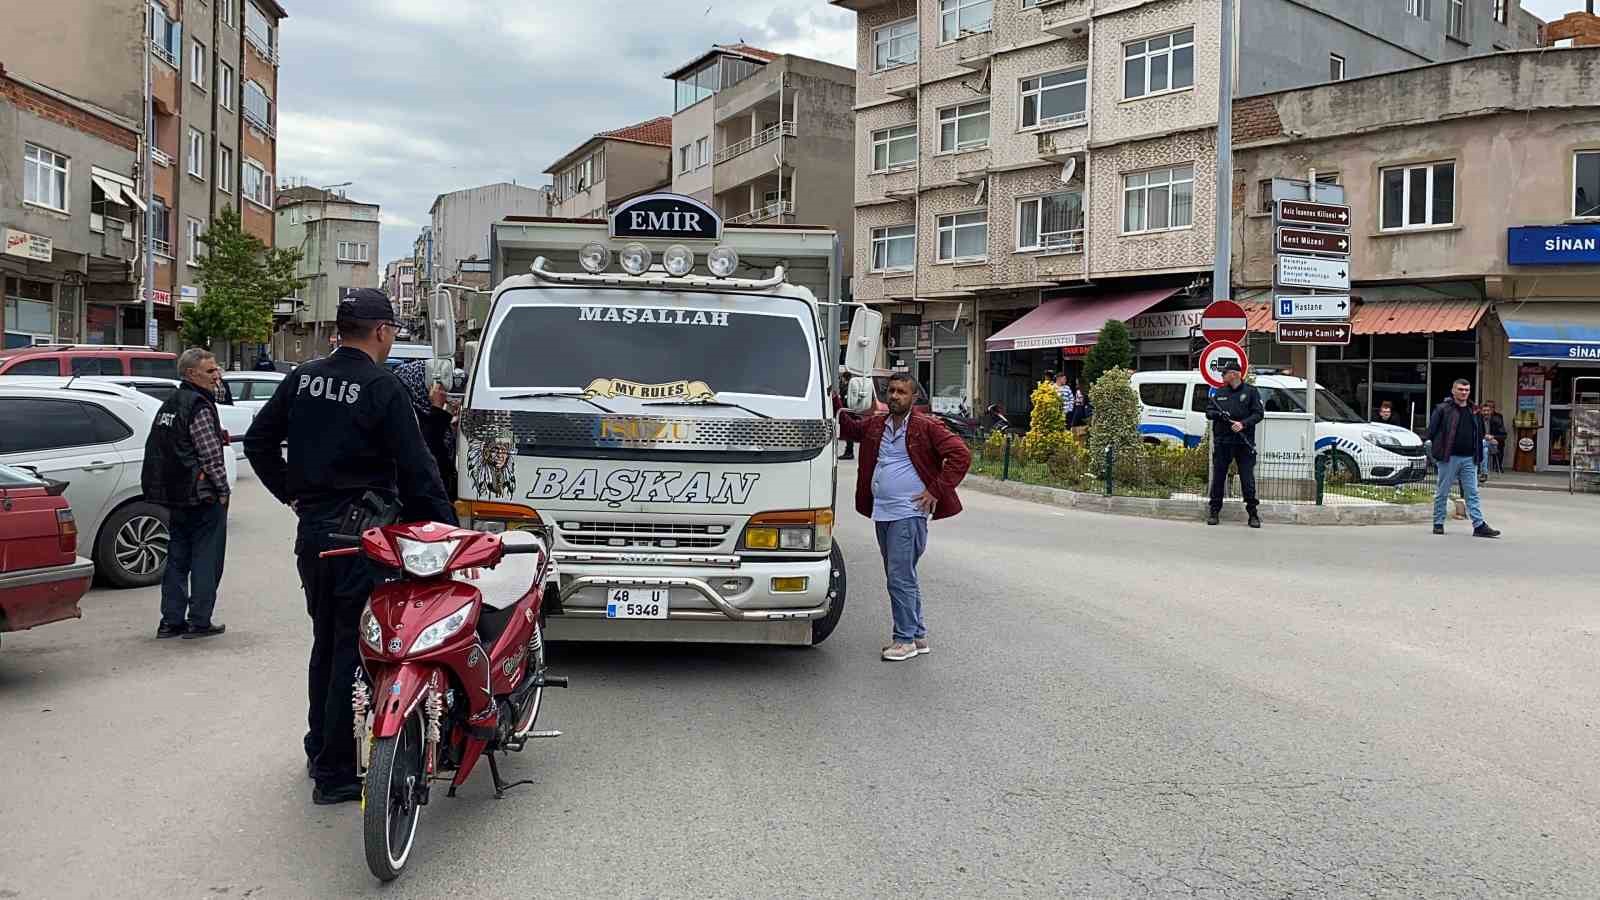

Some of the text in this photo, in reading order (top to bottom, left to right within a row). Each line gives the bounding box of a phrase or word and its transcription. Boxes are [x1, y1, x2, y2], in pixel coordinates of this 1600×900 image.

[1283, 207, 1295, 215] Aziz
[629, 206, 703, 232] EMİR
[1283, 235, 1325, 246] Kent Müzesi
[1545, 236, 1595, 251] SİNAN
[1283, 303, 1323, 313] H Hastane
[578, 307, 730, 327] MAŞALLAH
[1281, 328, 1336, 338] Muradiye Camii
[297, 374, 361, 404] POLİS
[615, 382, 684, 398] MY RULES
[601, 418, 694, 440] ISUZU
[527, 468, 760, 508] BAŞKAN
[613, 590, 660, 602] 48 U
[627, 604, 659, 616] 5348
